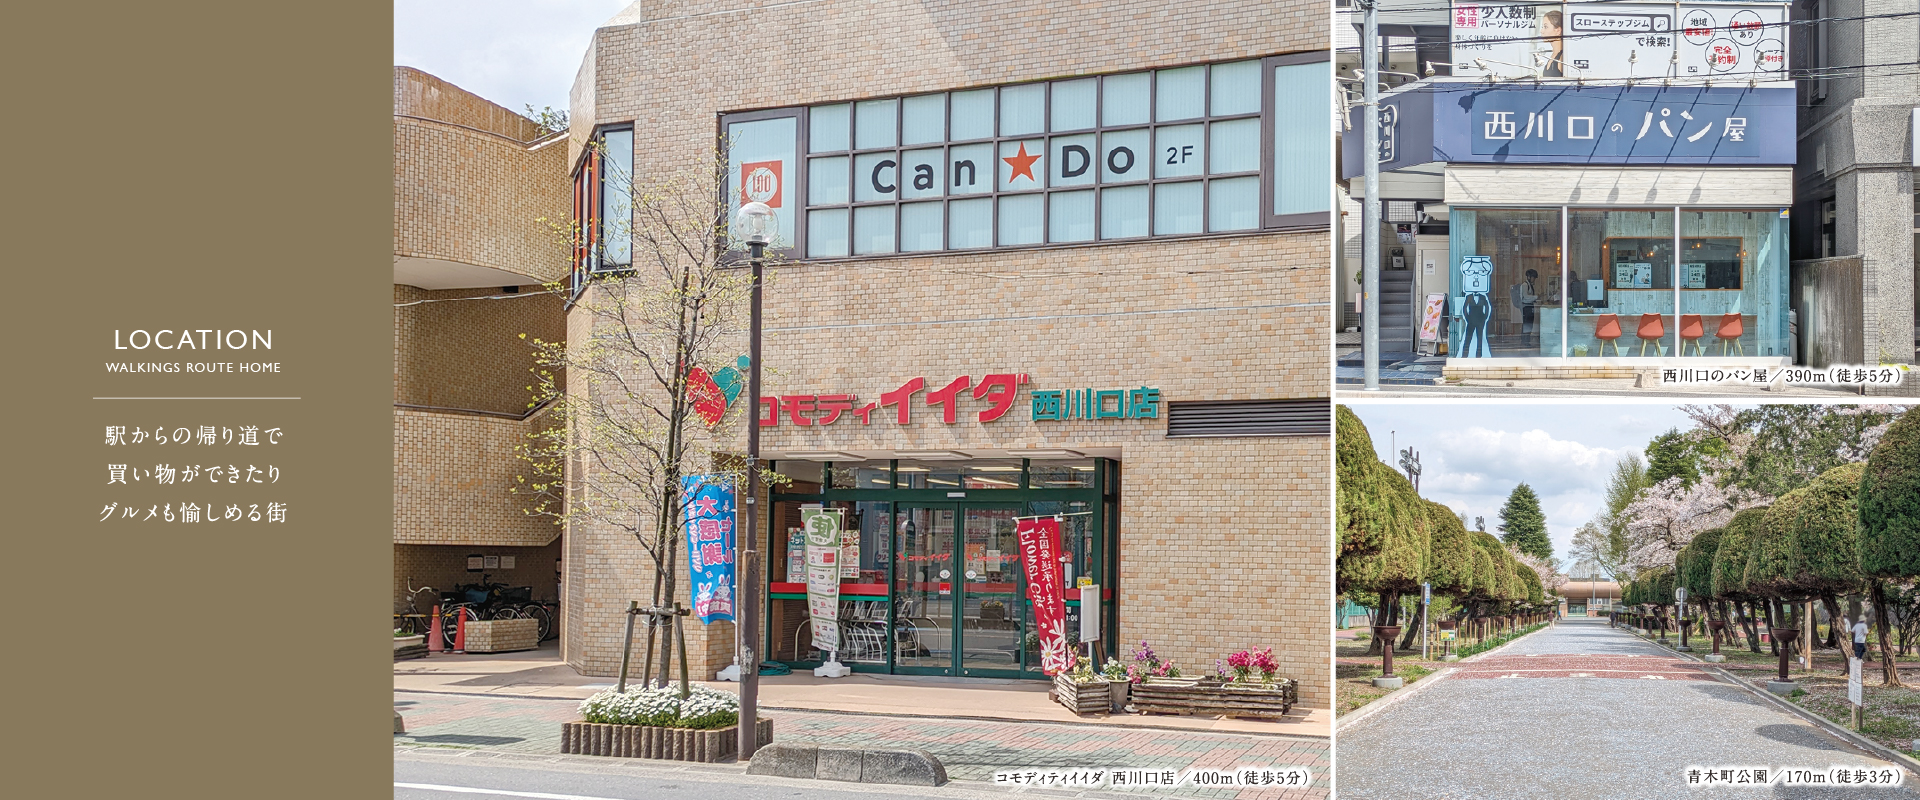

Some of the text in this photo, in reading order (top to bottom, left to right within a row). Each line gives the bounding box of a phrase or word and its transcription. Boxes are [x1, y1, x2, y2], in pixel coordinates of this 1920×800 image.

[1481, 5, 1537, 20] 少人数制
[1456, 16, 1477, 27] 専用
[1480, 20, 1536, 29] パーソナルジム
[1575, 18, 1650, 28] スローステップジム
[1690, 17, 1708, 27] 地域
[1739, 30, 1754, 39] あり
[1635, 36, 1671, 48] で検索!
[1713, 46, 1732, 55] 完全
[1485, 107, 1747, 143] 西川口のパン屋
[871, 144, 1194, 194] Can Do 2F
[759, 373, 1160, 427] コモディイイダ 西川口店
